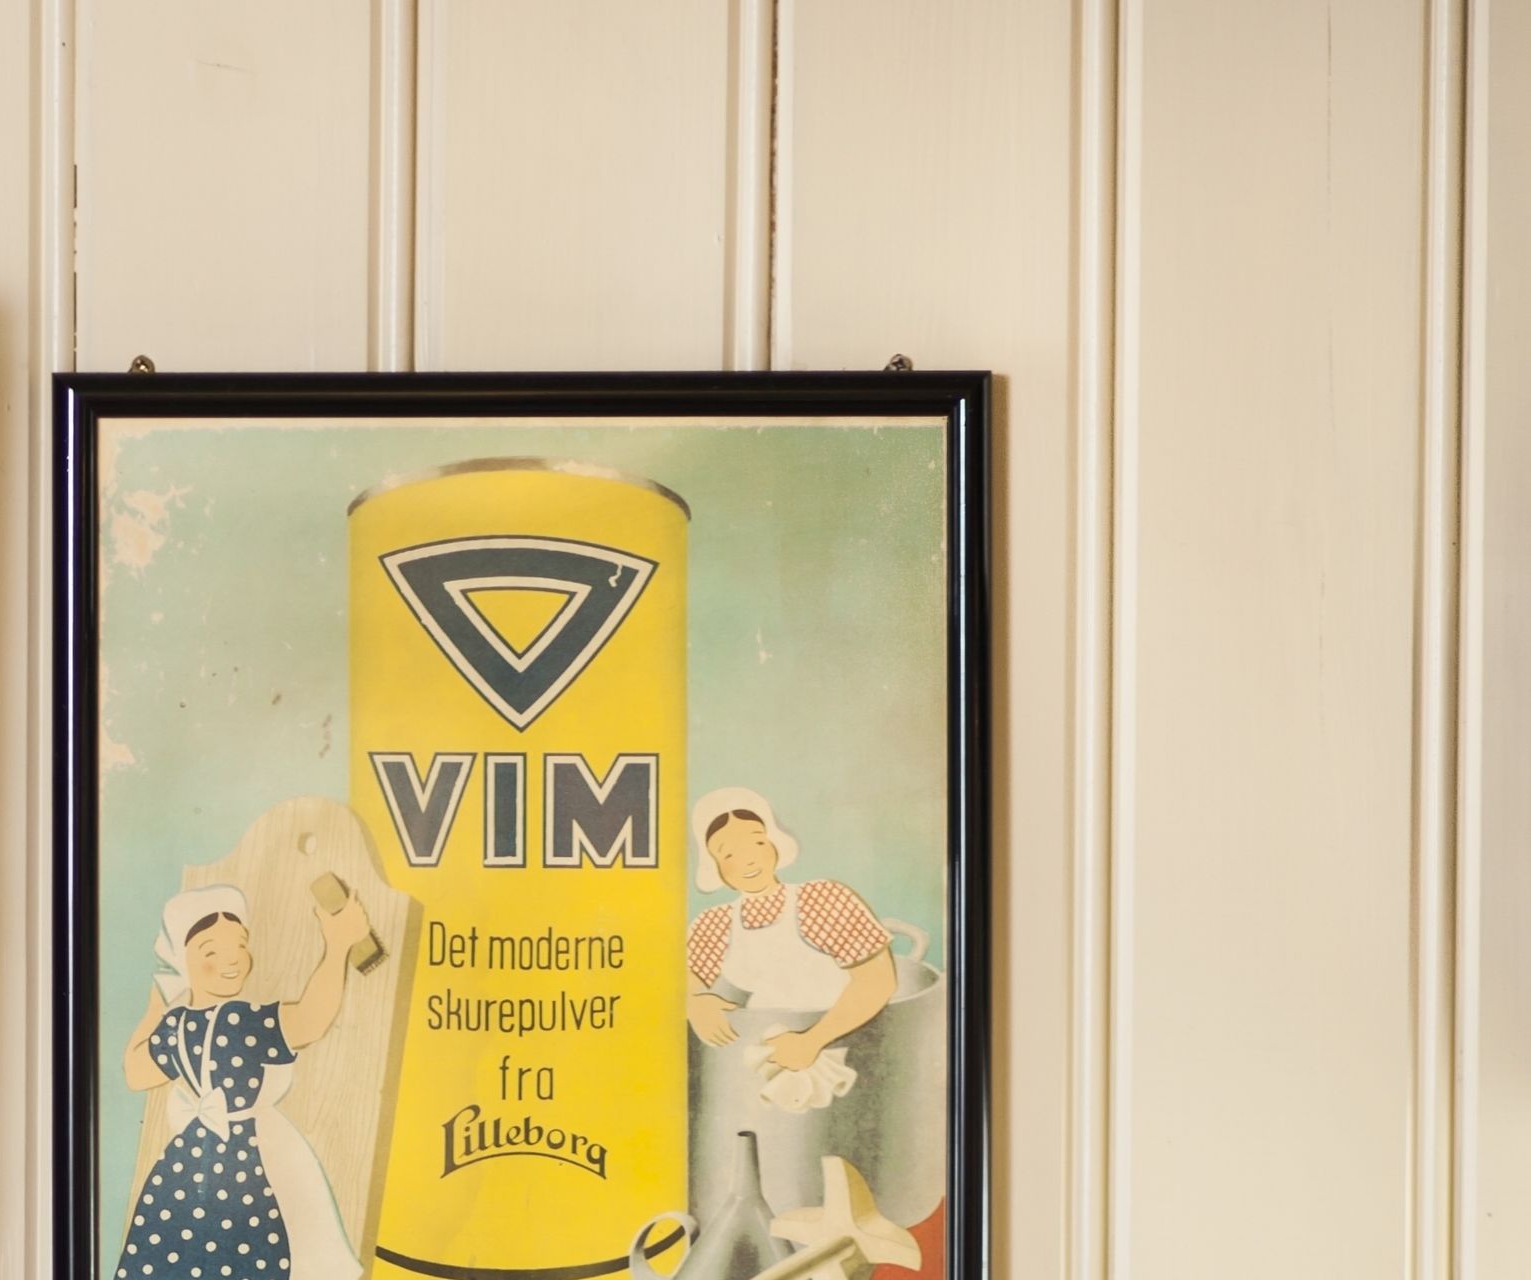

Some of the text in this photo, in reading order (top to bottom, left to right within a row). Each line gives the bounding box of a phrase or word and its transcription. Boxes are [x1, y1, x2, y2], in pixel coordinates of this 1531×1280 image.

[368, 752, 660, 869] VIM
[428, 920, 625, 971] Det moderne
[427, 988, 622, 1038] skurepulver
[498, 1055, 554, 1101] fra
[440, 1103, 608, 1180] Lilleborg
